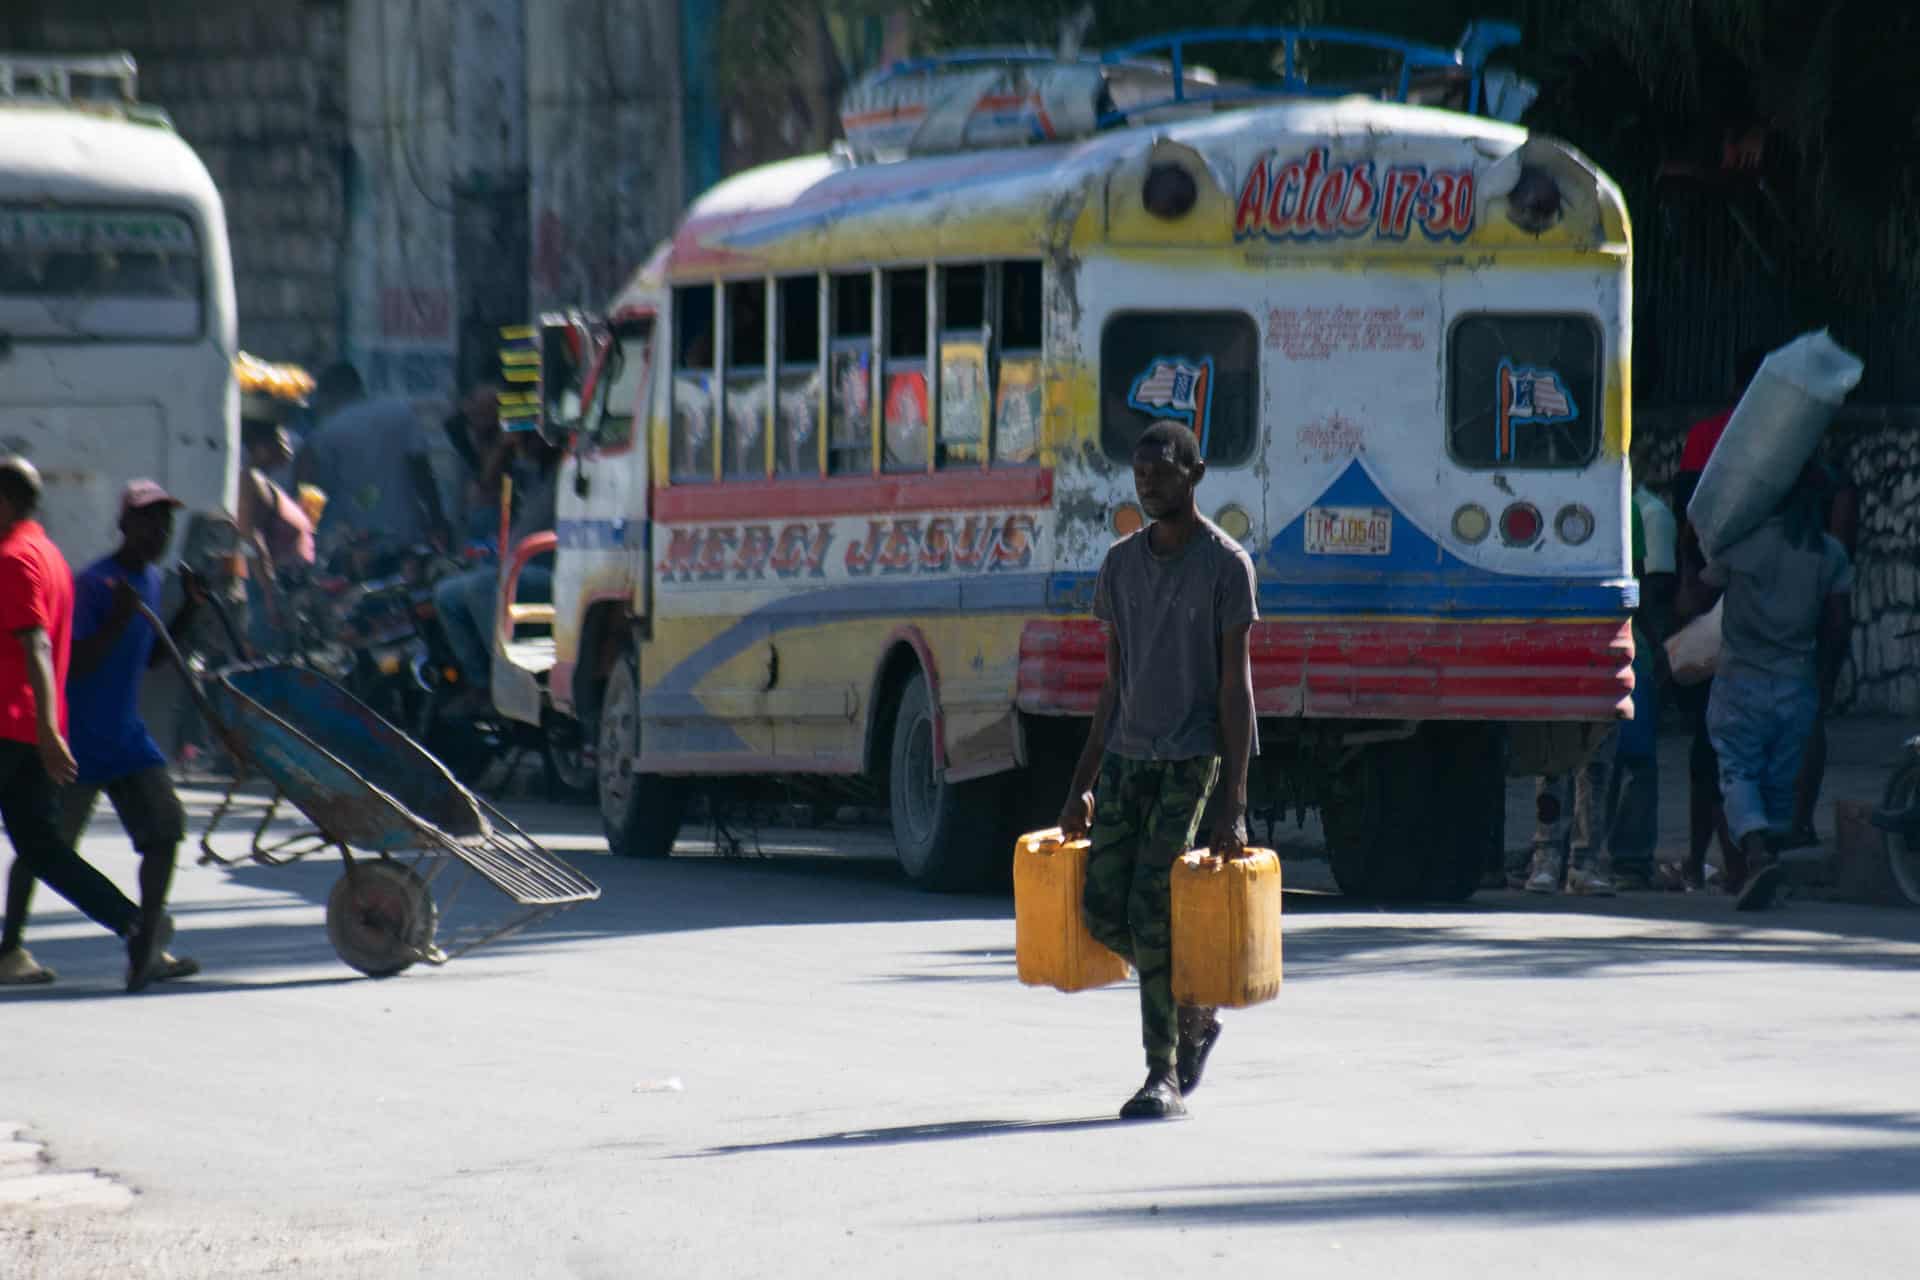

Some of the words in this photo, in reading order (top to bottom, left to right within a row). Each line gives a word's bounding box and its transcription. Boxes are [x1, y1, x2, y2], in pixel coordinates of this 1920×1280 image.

[1234, 147, 1376, 242] Actes
[1373, 165, 1475, 242] 17:30
[655, 521, 834, 583] MERCI
[844, 513, 1041, 577] JESUS
